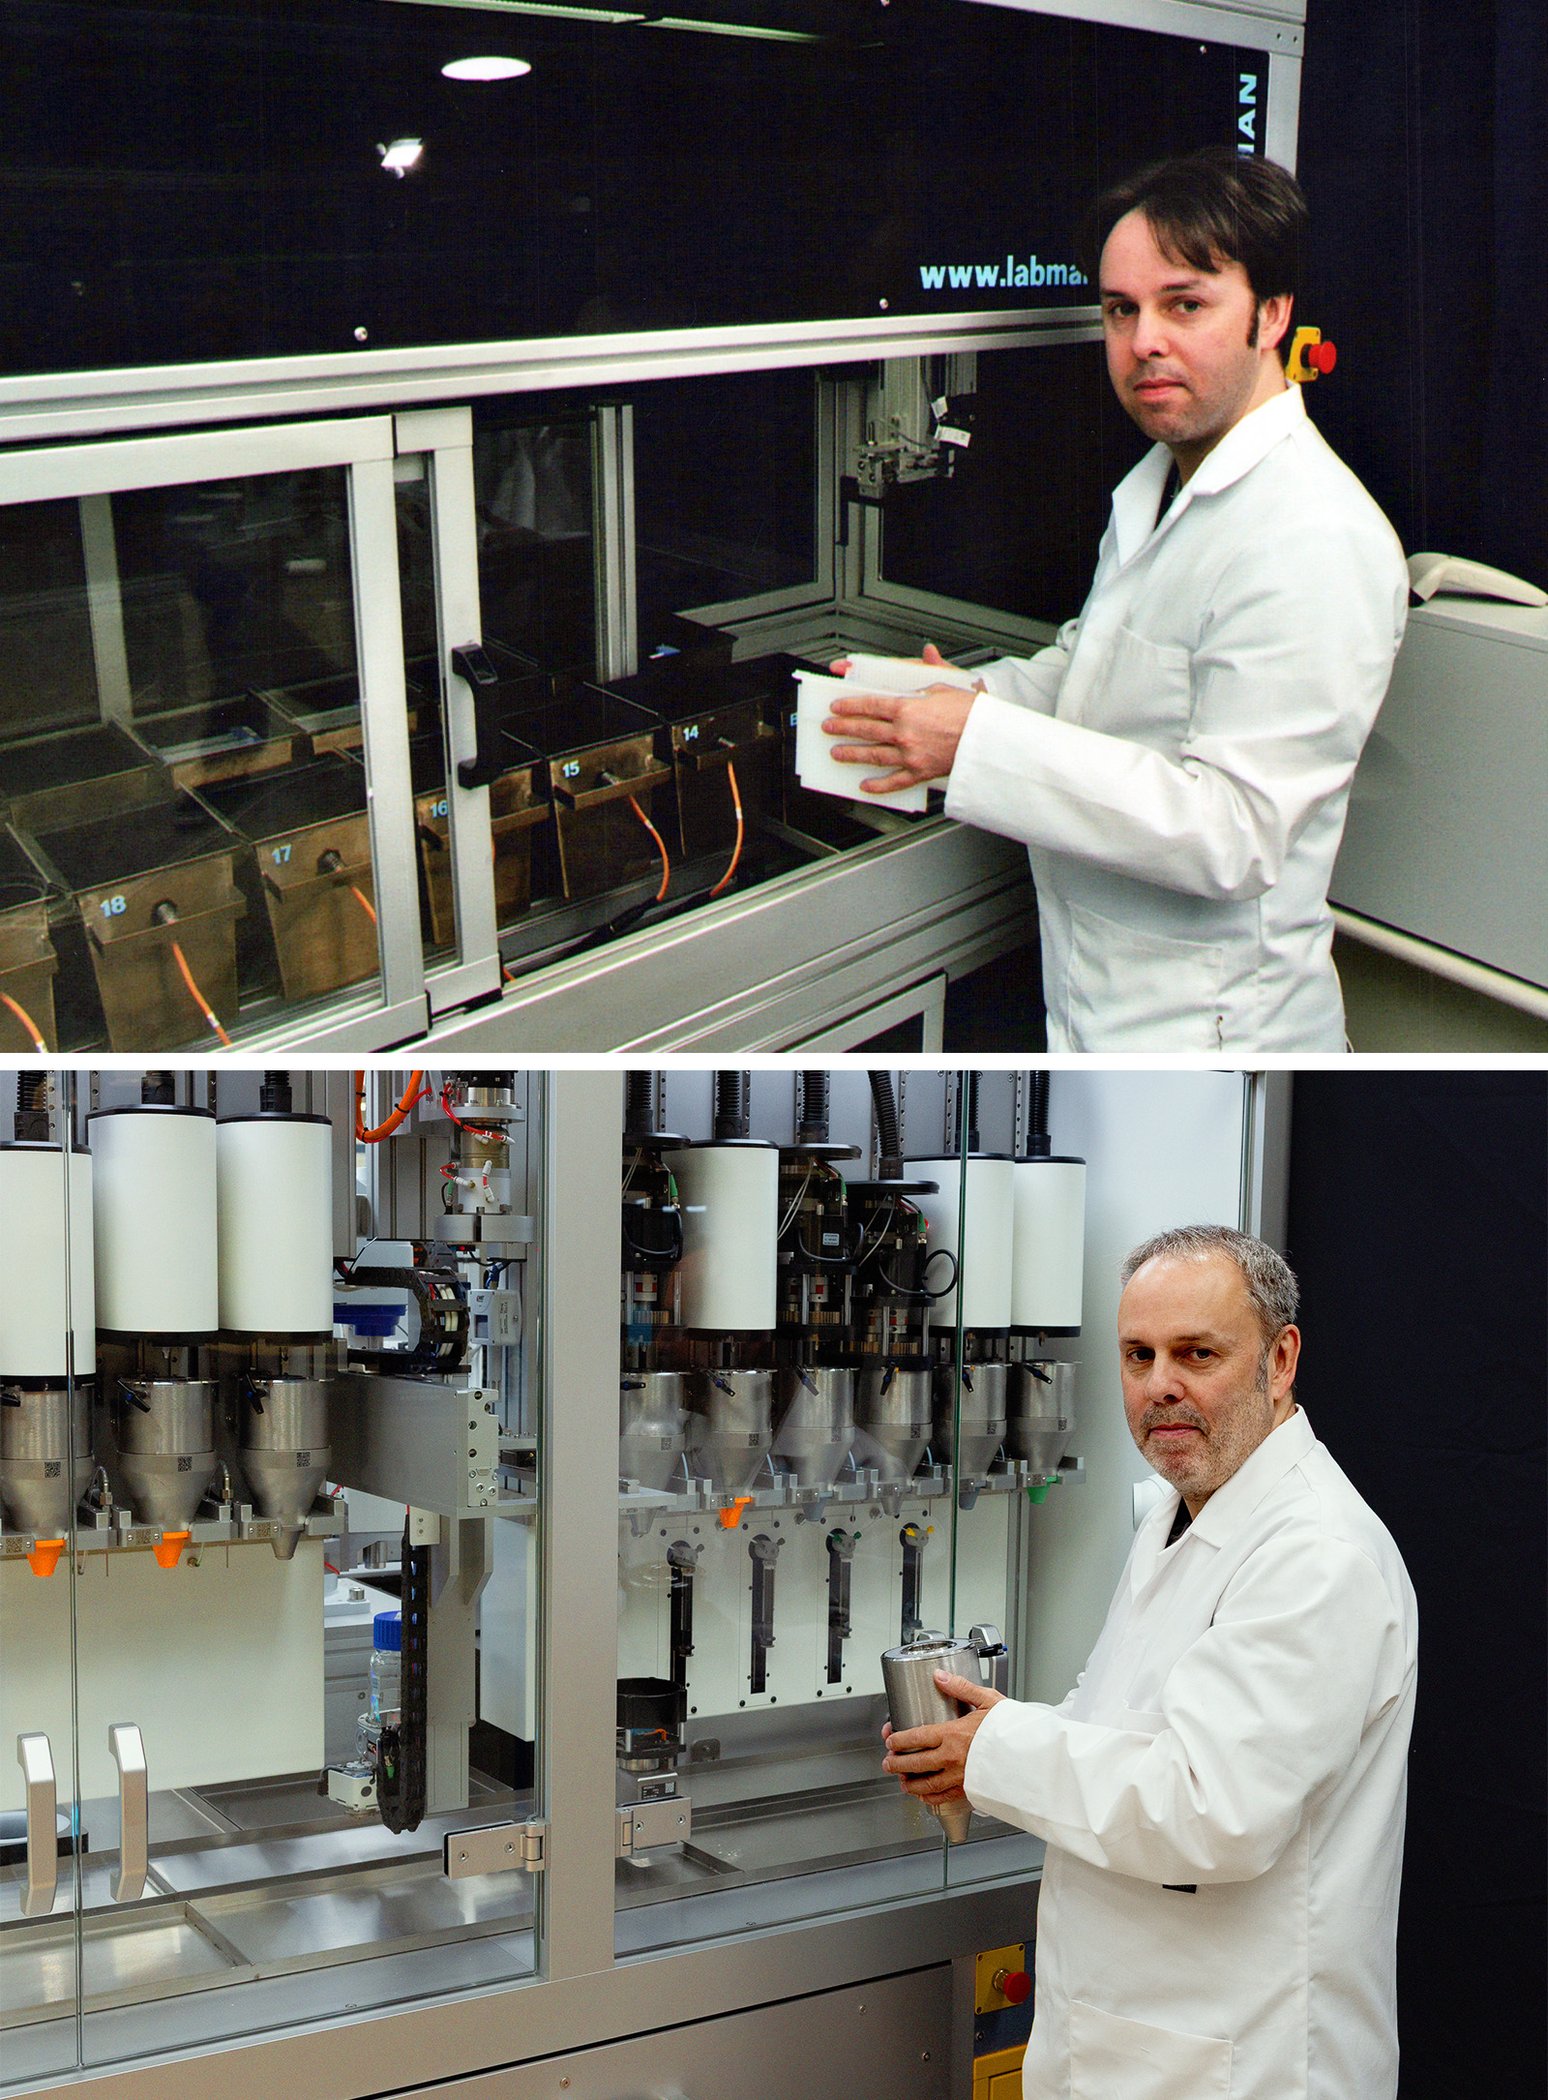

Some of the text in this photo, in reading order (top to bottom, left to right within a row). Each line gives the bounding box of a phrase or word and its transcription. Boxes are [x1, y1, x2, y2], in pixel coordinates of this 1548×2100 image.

[919, 255, 1088, 289] www.labma
[683, 724, 699, 741] 14
[562, 760, 580, 778] 15
[430, 801, 448, 818] 16
[271, 845, 292, 865] 17
[100, 895, 126, 918] 18
